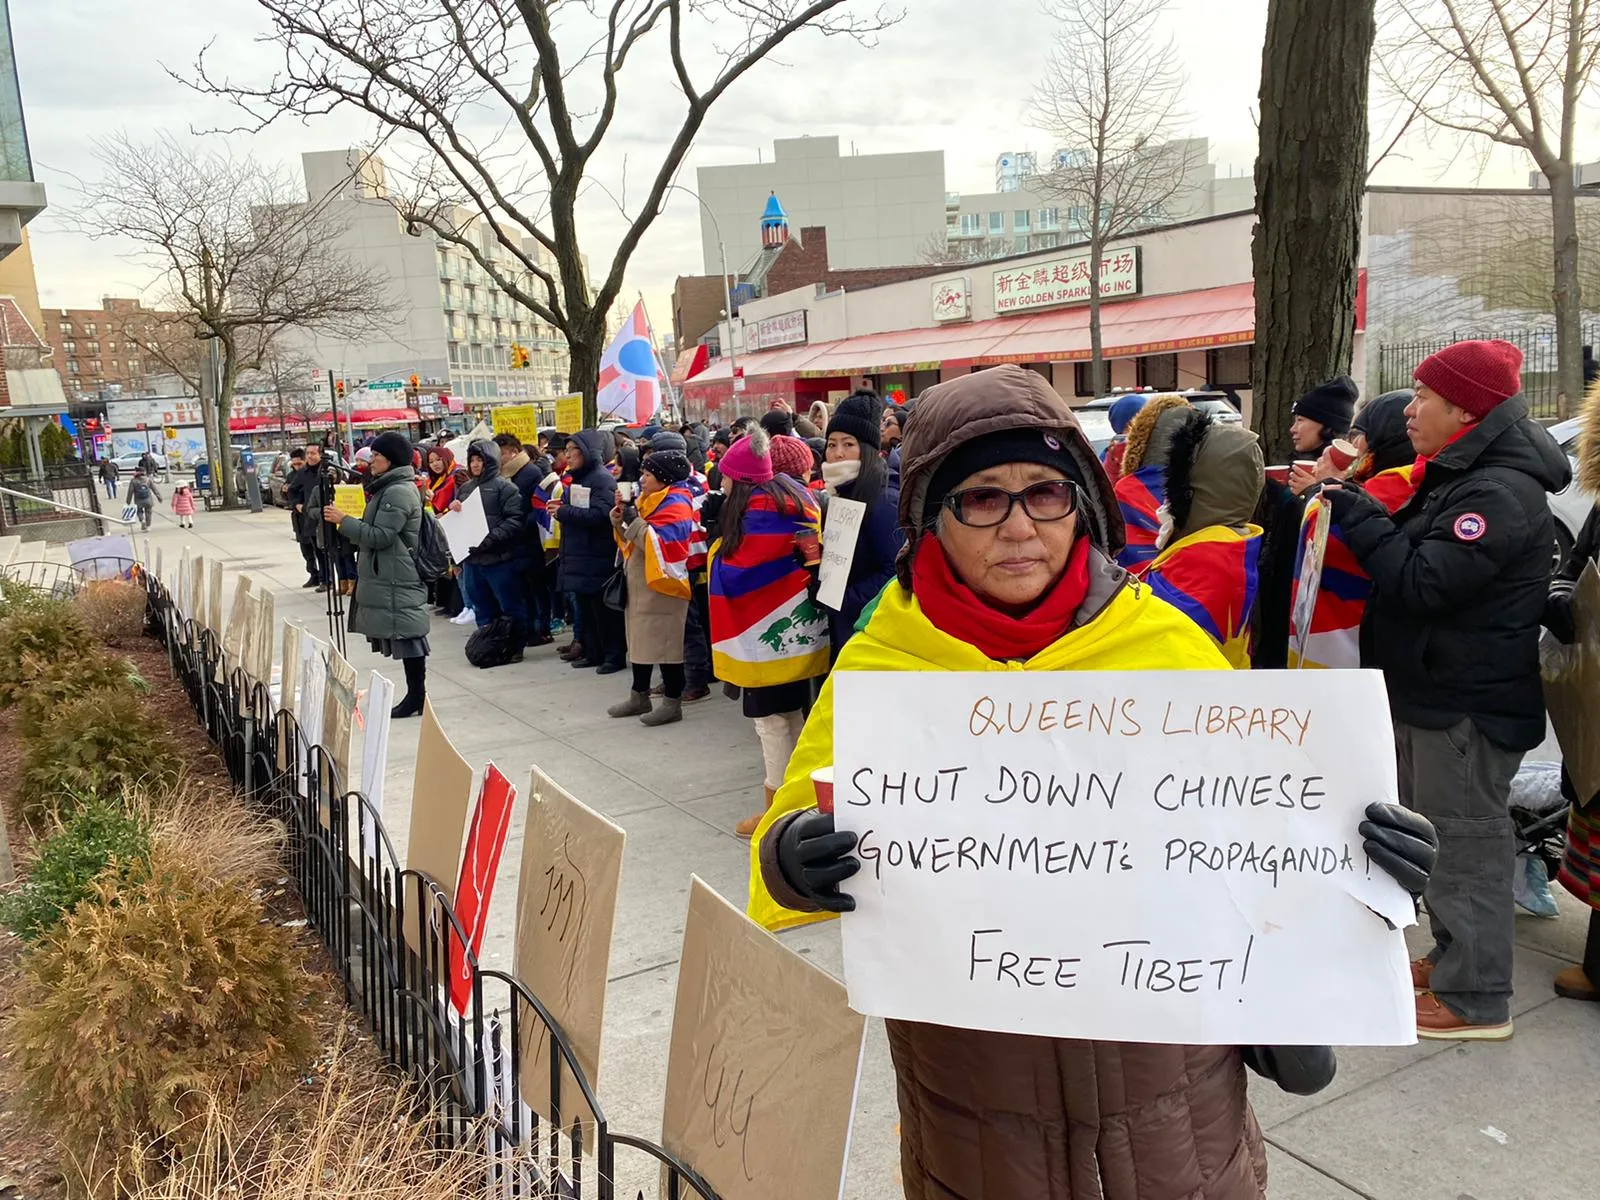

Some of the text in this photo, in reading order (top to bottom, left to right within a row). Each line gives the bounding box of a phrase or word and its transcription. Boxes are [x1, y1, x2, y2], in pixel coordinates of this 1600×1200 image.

[998, 280, 1132, 309] NEW GOLDEN SPARKLNG INC
[969, 695, 1312, 745] QUEENS LIBRARY
[847, 765, 1326, 812] SHUT DOWN CHINESE
[968, 927, 1256, 1004] FREE TIBET!
